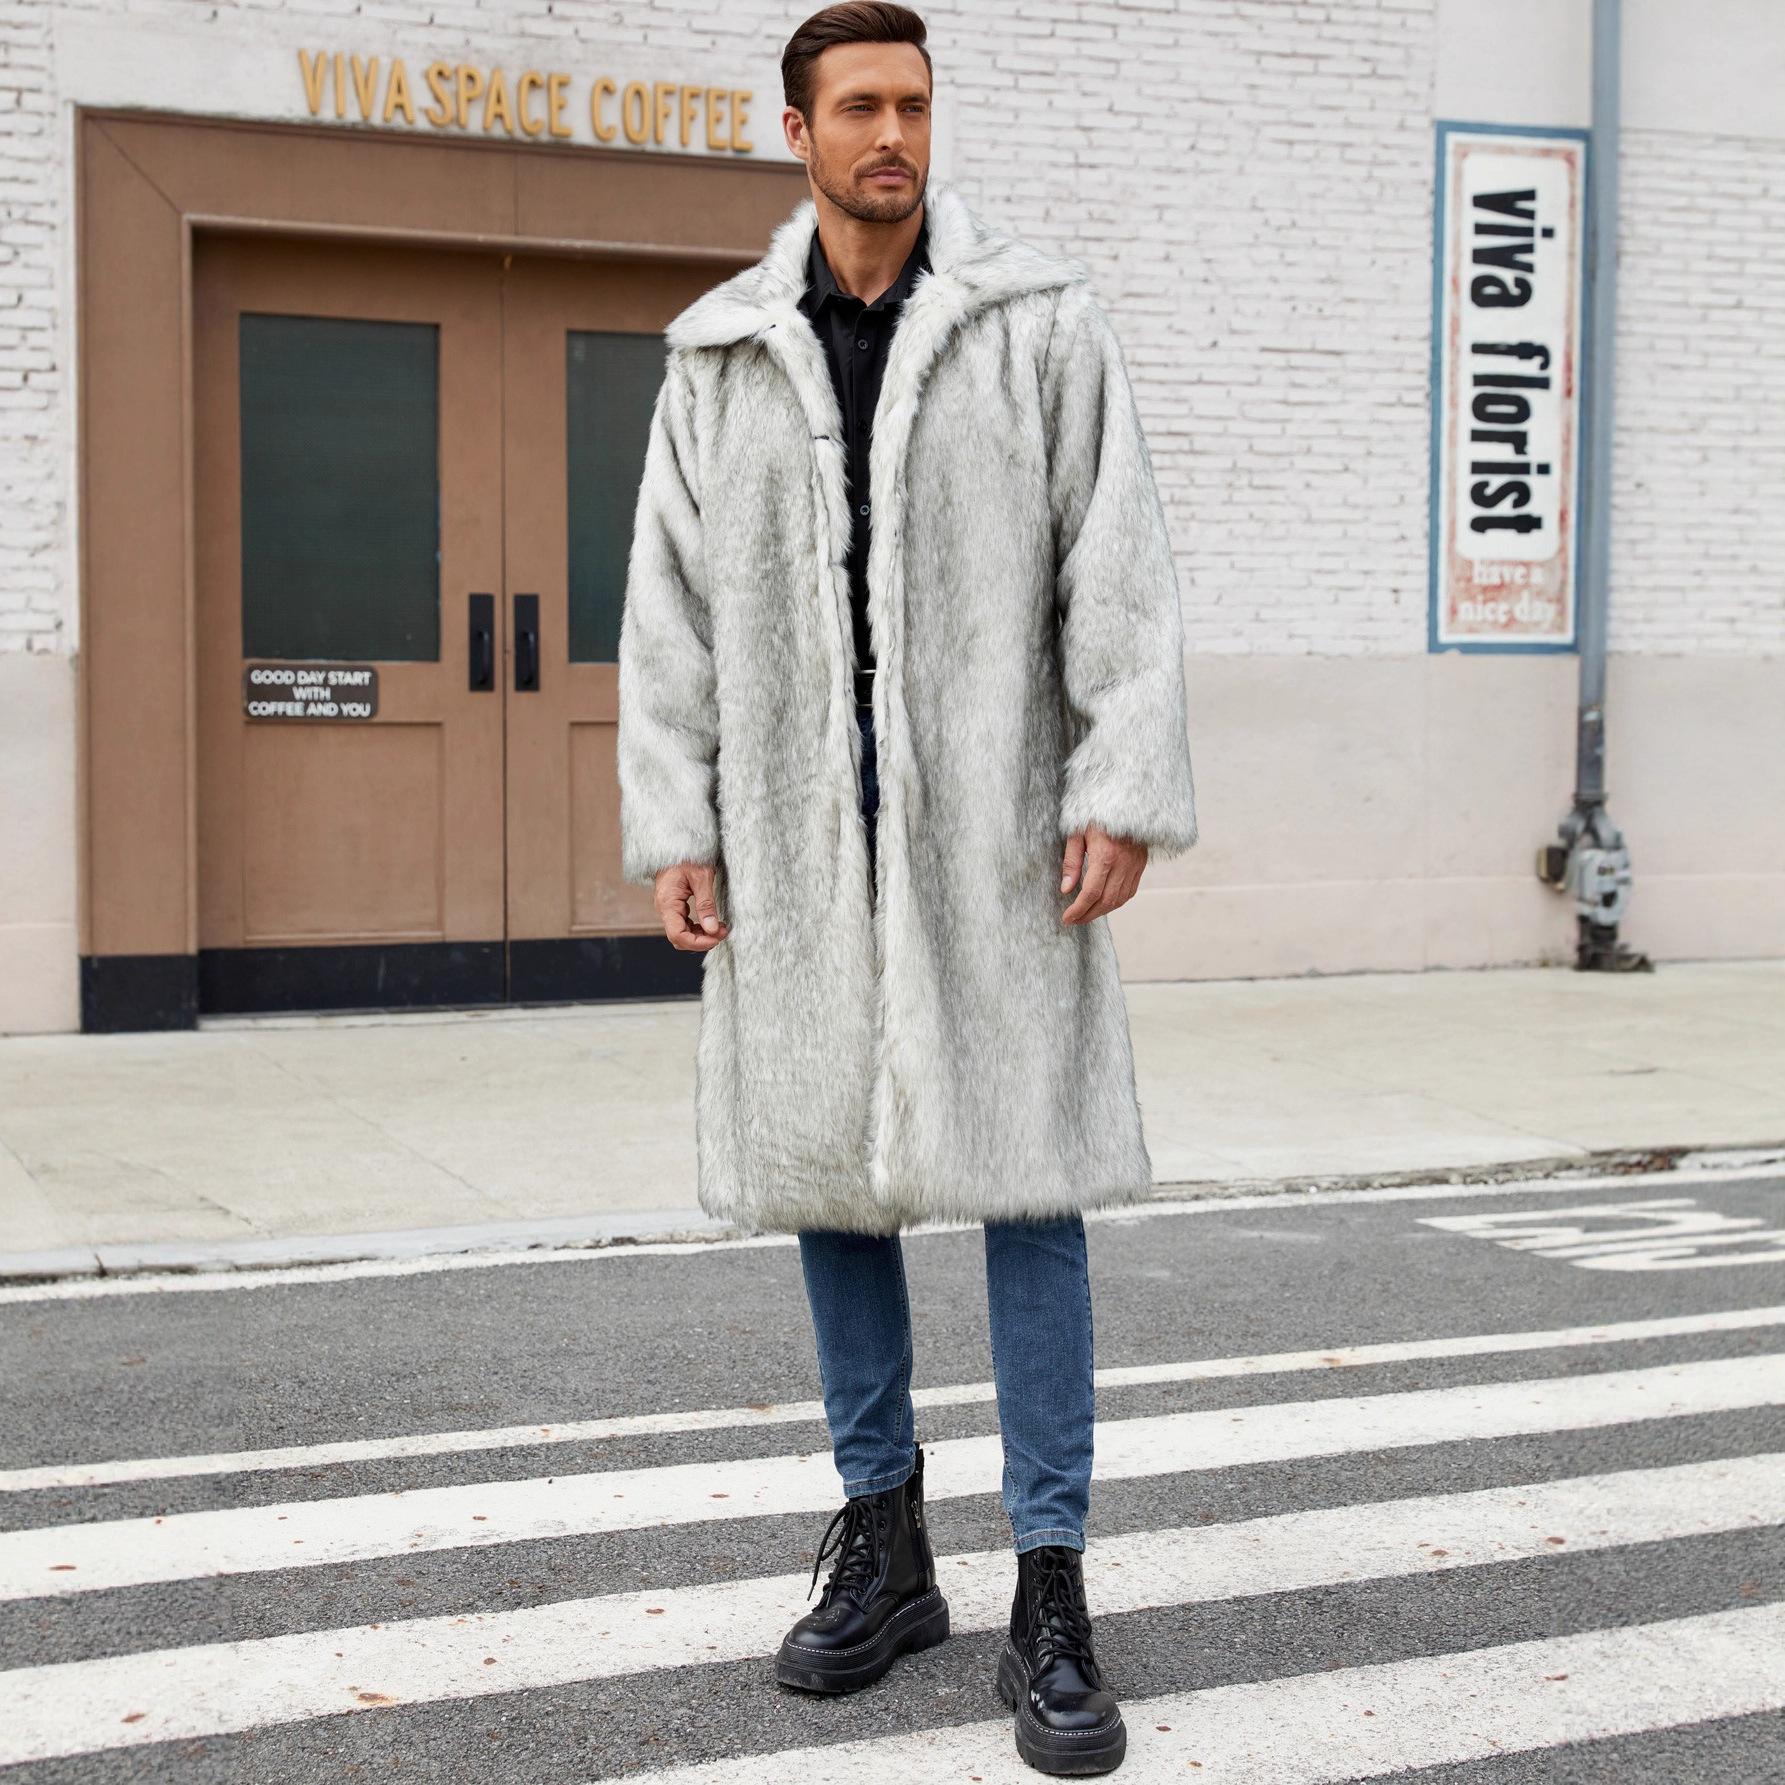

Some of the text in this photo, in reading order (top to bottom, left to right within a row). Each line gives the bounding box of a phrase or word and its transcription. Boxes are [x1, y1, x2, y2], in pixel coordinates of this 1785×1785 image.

[591, 77, 753, 151] COFFEE
[1470, 189, 1555, 533] viva florist
[1473, 559, 1528, 585] have
[1458, 590, 1556, 629] nice day
[251, 670, 371, 686] GOOD DAY START
[292, 687, 331, 700] WITH
[248, 701, 371, 717] COFFEE AND YOU
